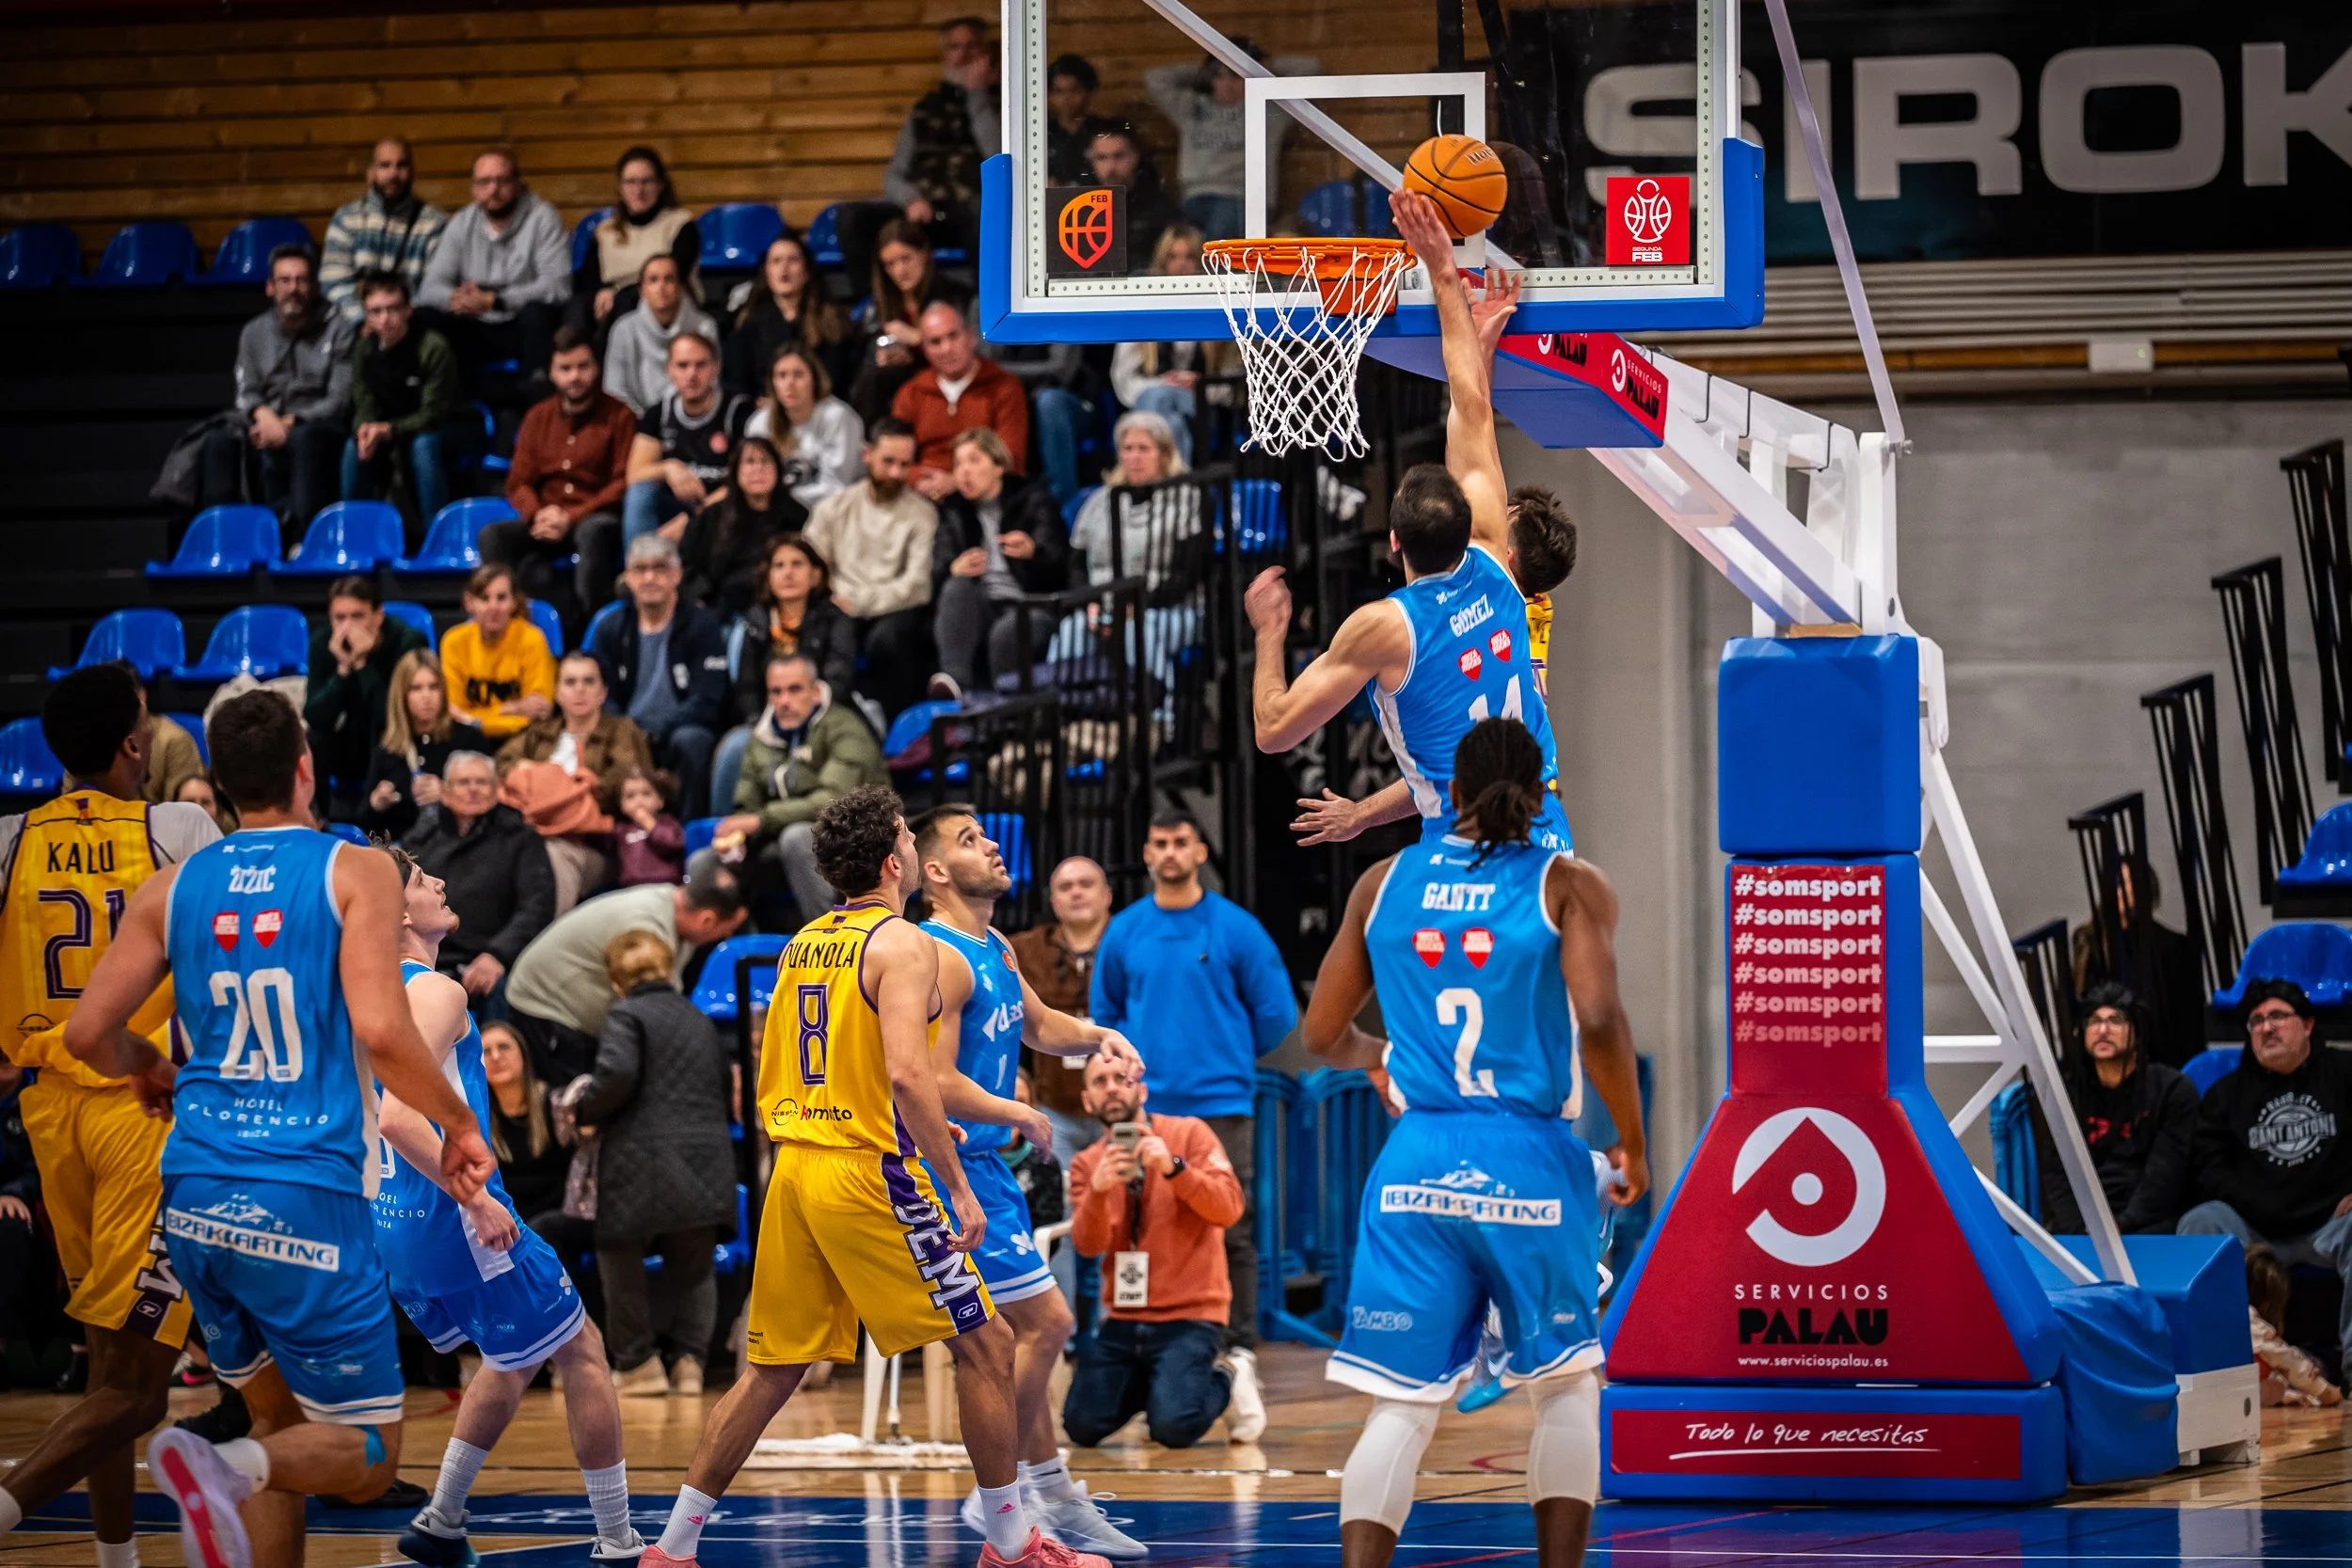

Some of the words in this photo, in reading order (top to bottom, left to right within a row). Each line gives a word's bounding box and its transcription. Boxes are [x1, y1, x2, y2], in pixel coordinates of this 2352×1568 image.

[1090, 194, 1108, 203] FEB
[1631, 251, 1663, 262] FEB
[1552, 333, 1588, 368] PALAU
[1627, 358, 1662, 395] SERVICIOS
[1626, 374, 1661, 420] PALAU
[47, 840, 116, 875] KALU
[1421, 881, 1497, 912] GANTT
[1735, 874, 1882, 902] #somsport
[1735, 903, 1882, 931] #somsport
[1735, 932, 1882, 960] #somsport
[1735, 961, 1882, 990] #somsport
[1735, 990, 1882, 1019] #somsport
[209, 967, 304, 1083] 20
[797, 982, 830, 1087] 8
[1735, 1021, 1882, 1048] #somsport
[1435, 987, 1500, 1099] 2
[188, 1102, 329, 1127] FLORENCIO
[234, 1097, 284, 1113] HOTEL
[1734, 1284, 1888, 1301] SERVICIOS
[1738, 1307, 1888, 1346] PALAU
[1738, 1354, 1889, 1370] www.serviciospalau.es
[1686, 1422, 1736, 1441] Todo
[1744, 1422, 1765, 1445] lo
[1772, 1423, 1811, 1445] que
[1820, 1423, 1929, 1445] necesitas
